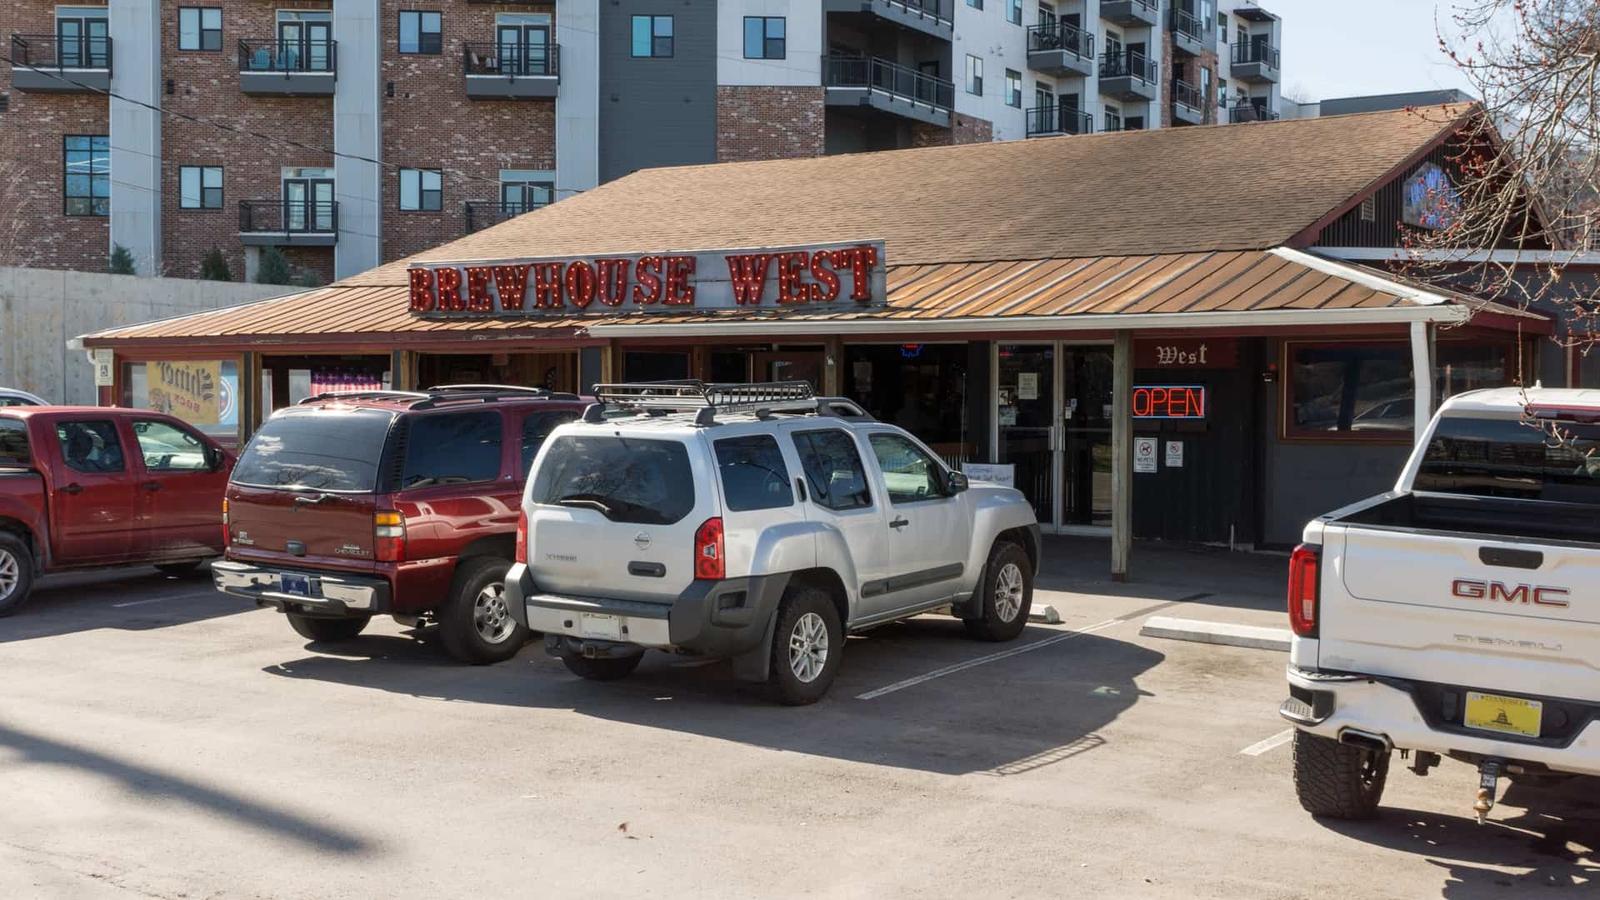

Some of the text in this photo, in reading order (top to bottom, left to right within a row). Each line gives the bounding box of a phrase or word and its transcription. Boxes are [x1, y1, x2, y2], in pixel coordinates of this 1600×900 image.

[407, 244, 877, 312] BREWHOUSE WEST
[1156, 344, 1207, 364] West
[1133, 388, 1203, 416] OPEN
[1452, 577, 1570, 609] GMC
